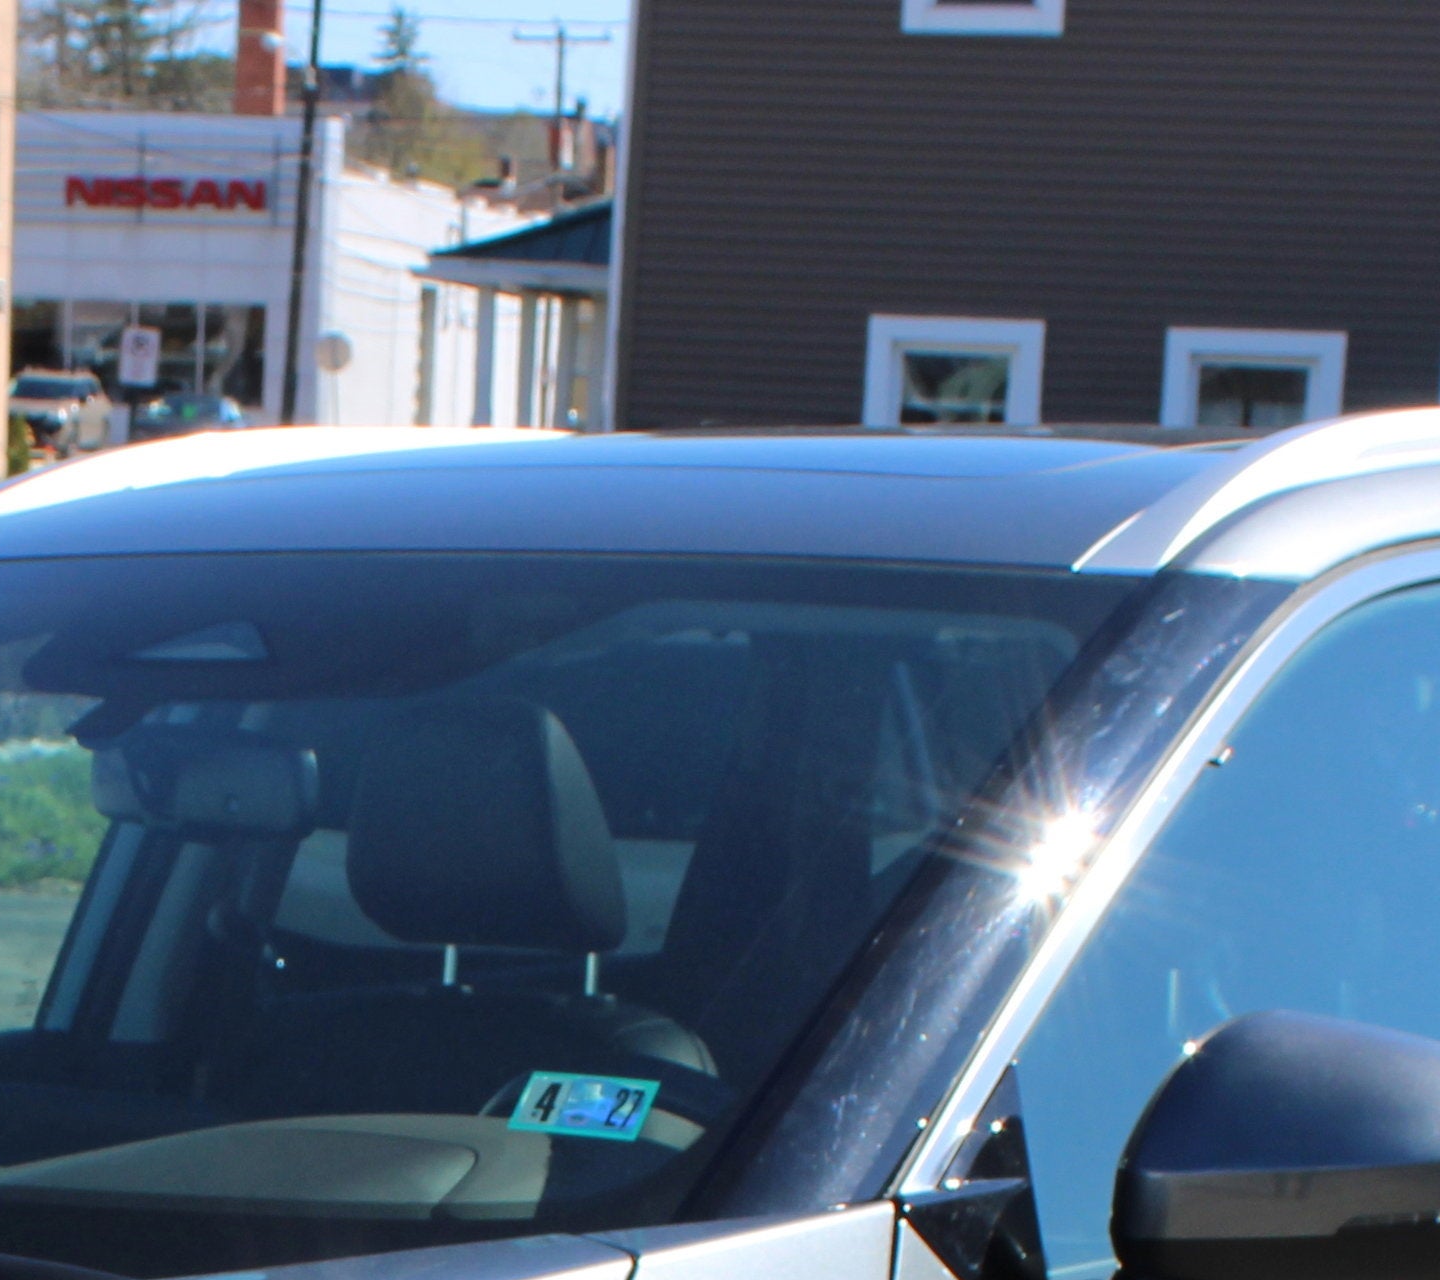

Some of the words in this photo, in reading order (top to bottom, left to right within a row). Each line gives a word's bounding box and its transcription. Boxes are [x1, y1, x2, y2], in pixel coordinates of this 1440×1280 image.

[65, 175, 266, 211] NISSAN
[534, 1082, 562, 1122] 4
[604, 1087, 645, 1128] 27
